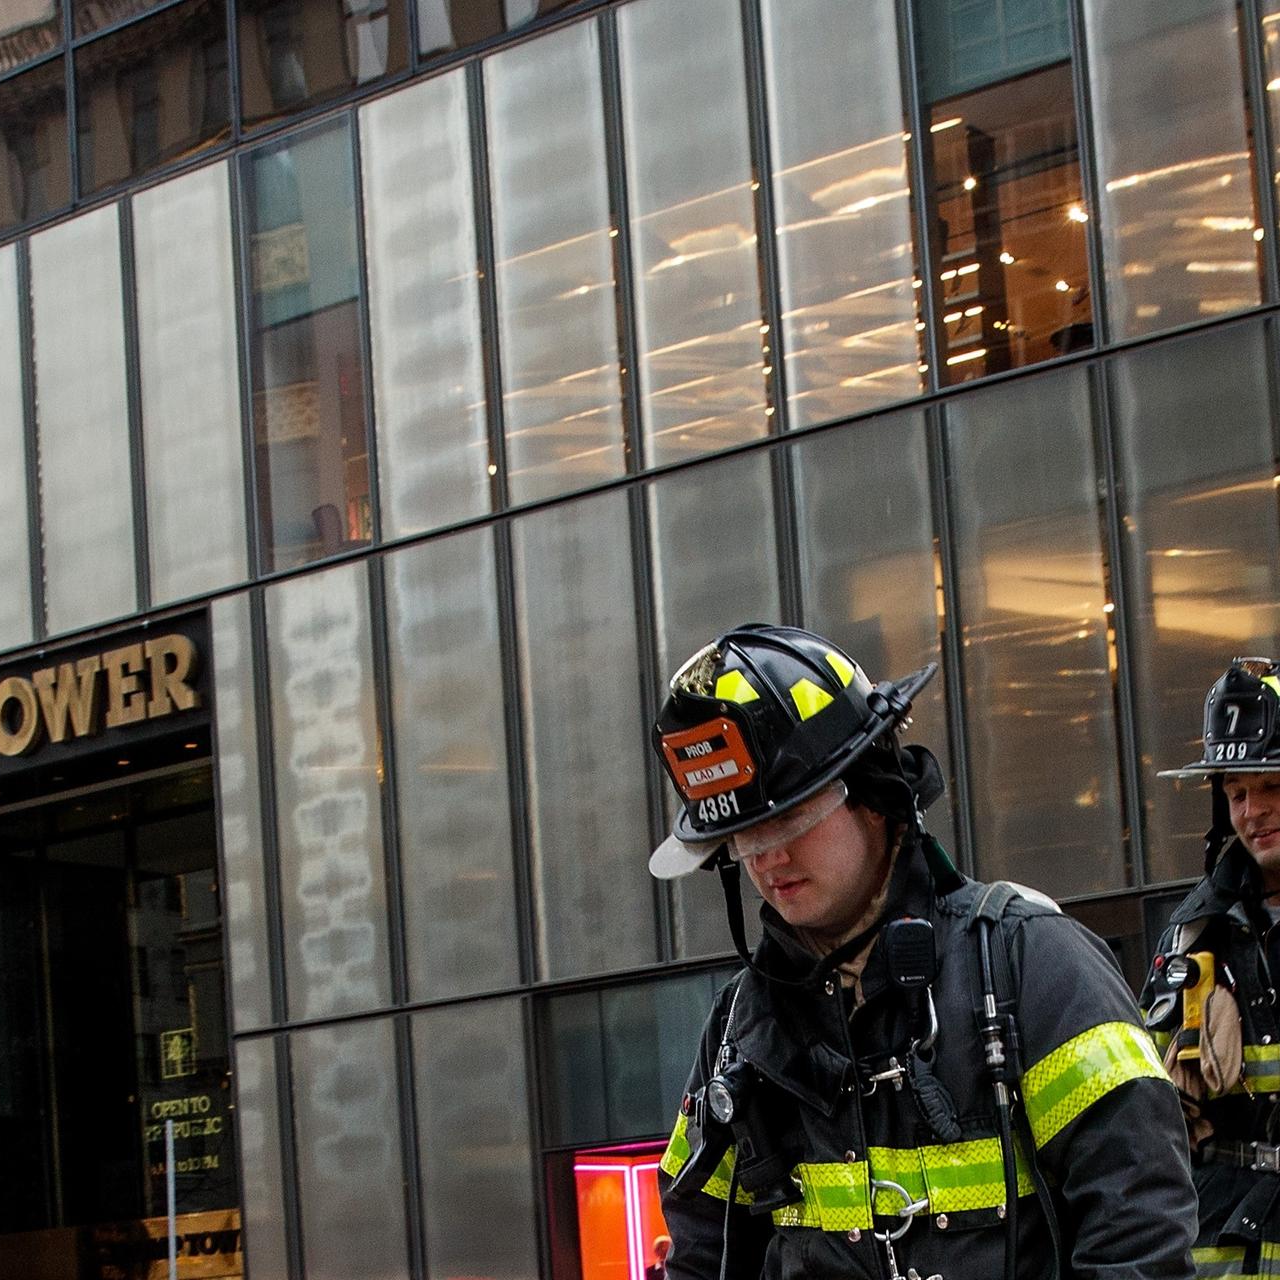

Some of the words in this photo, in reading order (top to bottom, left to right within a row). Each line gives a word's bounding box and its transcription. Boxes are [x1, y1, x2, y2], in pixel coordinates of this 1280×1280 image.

[1226, 706, 1240, 735] 7
[684, 741, 713, 758] PROB
[1215, 742, 1247, 760] 209
[694, 769, 714, 782] LAD
[698, 790, 740, 823] 4381
